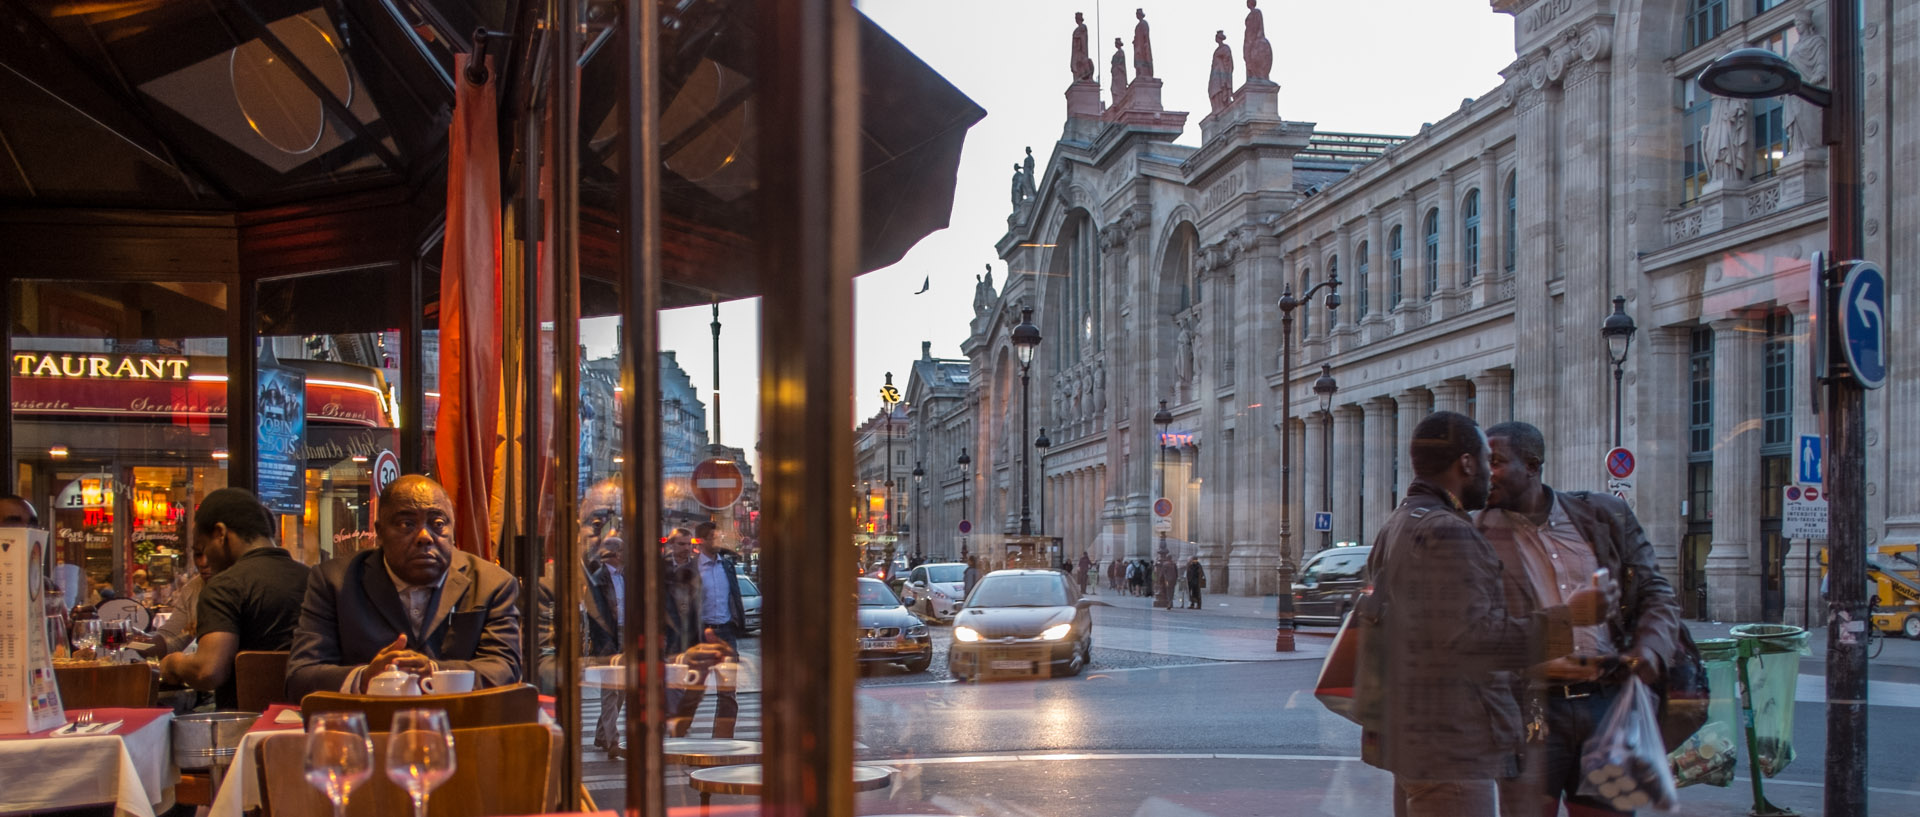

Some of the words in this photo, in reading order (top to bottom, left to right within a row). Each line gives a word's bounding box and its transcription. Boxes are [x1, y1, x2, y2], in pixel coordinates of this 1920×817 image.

[1532, 0, 1572, 31] NORD
[1208, 174, 1237, 209] NORD
[13, 353, 189, 379] TAURANT
[130, 397, 198, 412] Service
[381, 466, 397, 486] 30
[84, 532, 108, 543] NORD
